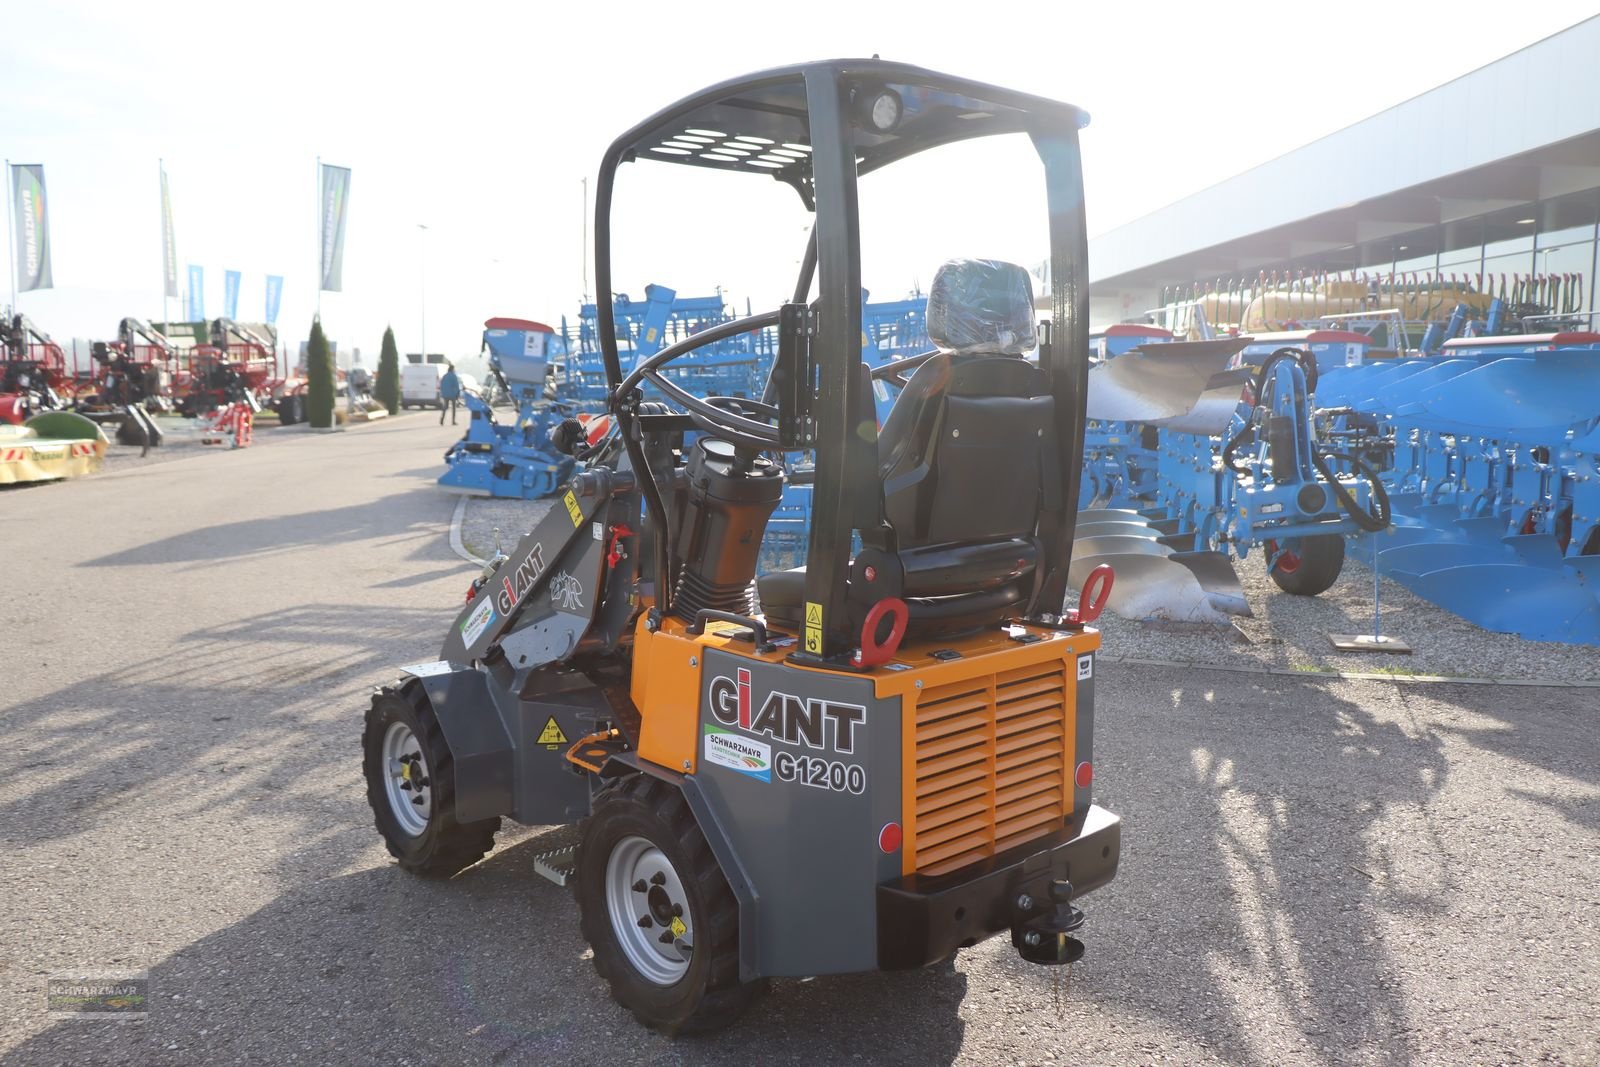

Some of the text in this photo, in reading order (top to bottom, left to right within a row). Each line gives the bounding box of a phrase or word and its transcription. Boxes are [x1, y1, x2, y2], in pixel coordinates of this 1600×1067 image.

[23, 190, 37, 277] SCHWARZMAYR
[710, 734, 762, 759] SCHWARZMAYR
[775, 751, 866, 794] G1200
